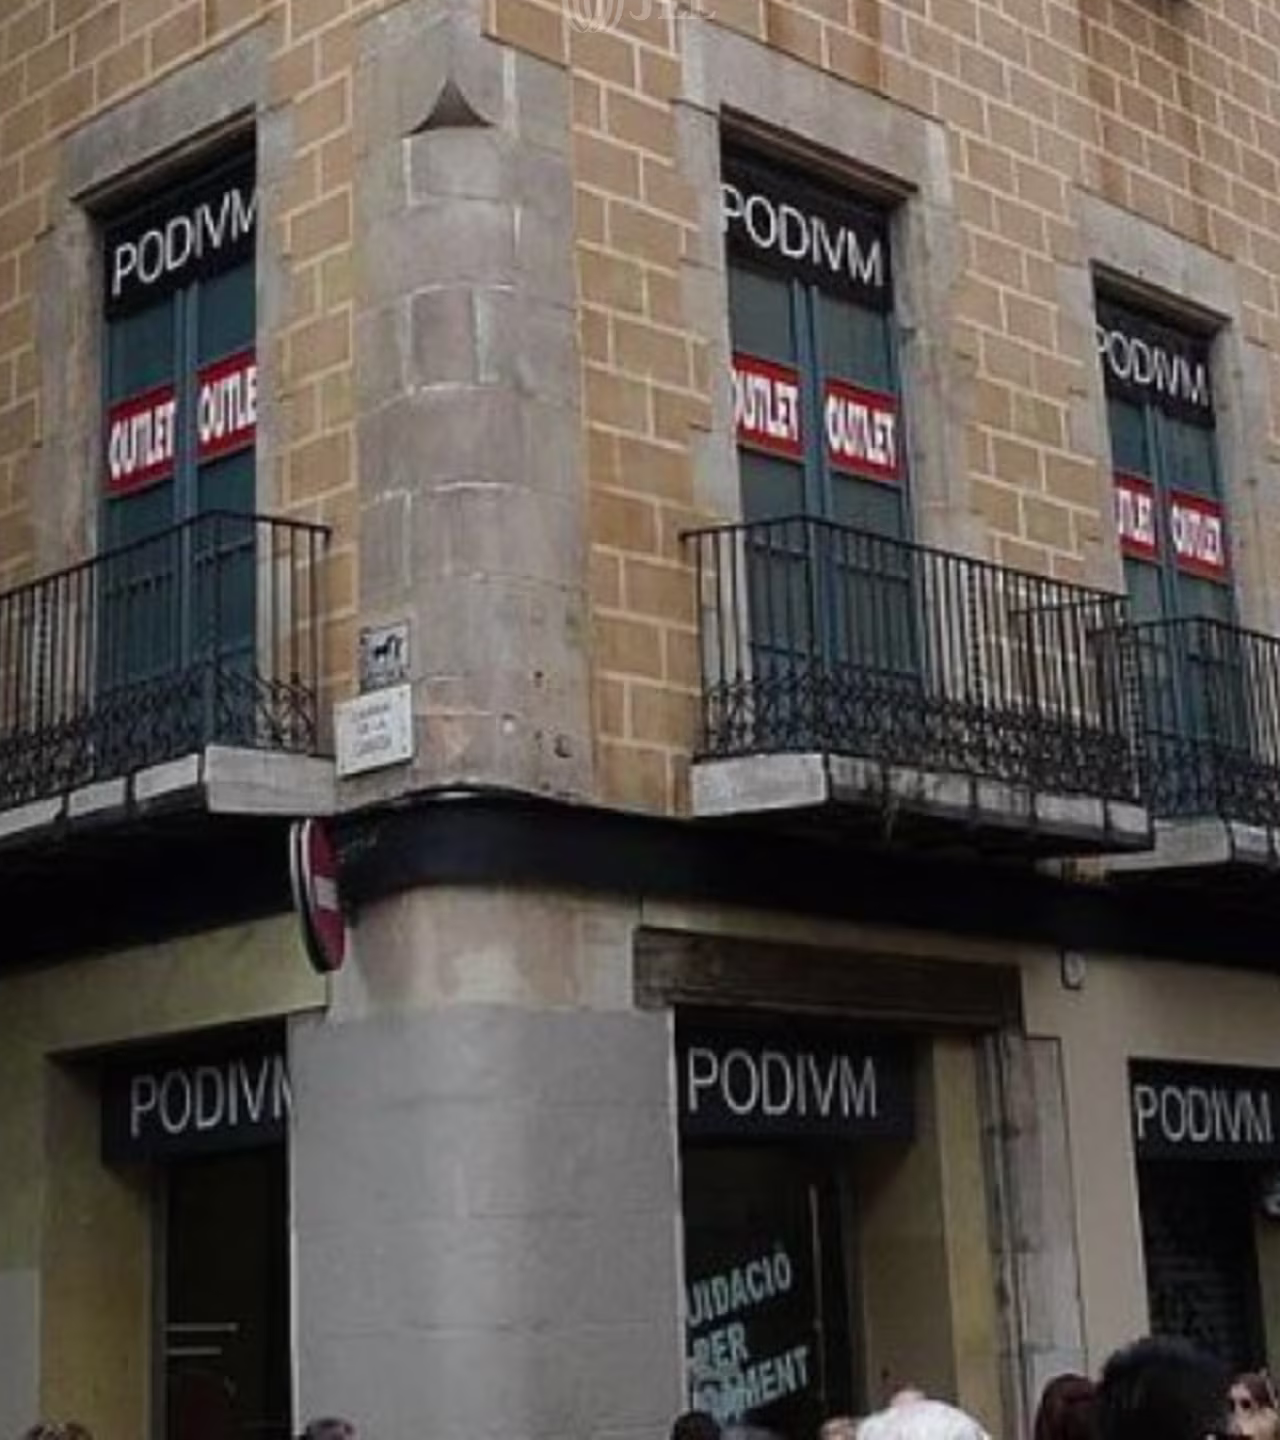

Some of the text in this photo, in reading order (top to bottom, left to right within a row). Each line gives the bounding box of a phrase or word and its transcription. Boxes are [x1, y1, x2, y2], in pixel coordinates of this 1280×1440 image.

[720, 182, 884, 287] PODIVM
[108, 365, 257, 481] OUTLET OUTLE
[825, 393, 897, 469] OUTLET
[687, 1047, 877, 1118] PODIVM
[1134, 1084, 1274, 1143] PODIVM
